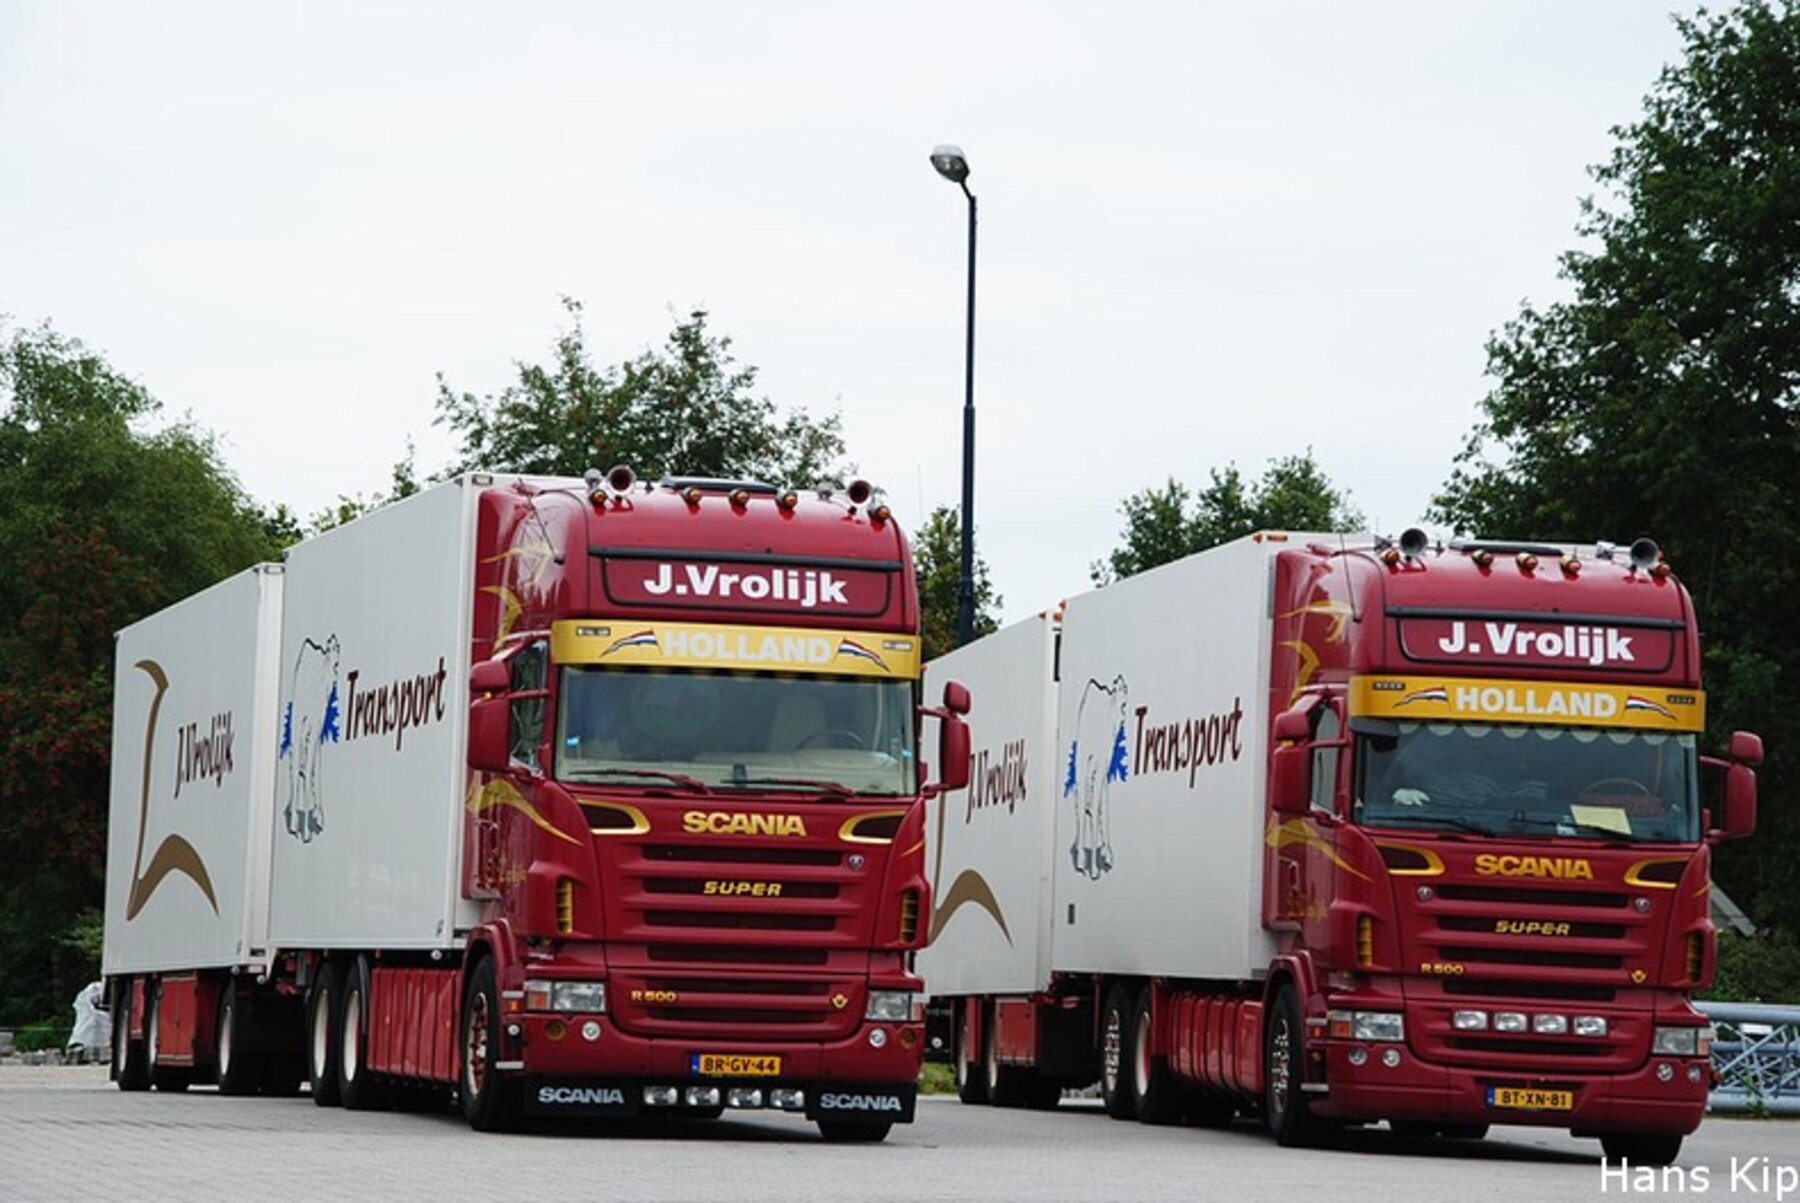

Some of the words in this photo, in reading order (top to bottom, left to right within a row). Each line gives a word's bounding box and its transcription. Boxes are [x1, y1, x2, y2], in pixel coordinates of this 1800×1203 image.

[644, 564, 848, 606] J.Vrolijk
[662, 632, 832, 664] HOLLAND
[346, 657, 447, 751] Transport
[1456, 687, 1617, 718] HOLLAND
[1134, 697, 1243, 788] Transport
[682, 811, 807, 837] SCANIA
[1474, 854, 1594, 881] SCANIA
[703, 881, 783, 898] SUPER
[1495, 920, 1571, 936] SUPER
[703, 1056, 776, 1073] BR-GV-44
[538, 1088, 624, 1105] SCANIA
[820, 1094, 902, 1112] SCANIA
[1501, 1090, 1567, 1107] BT-XN-81
